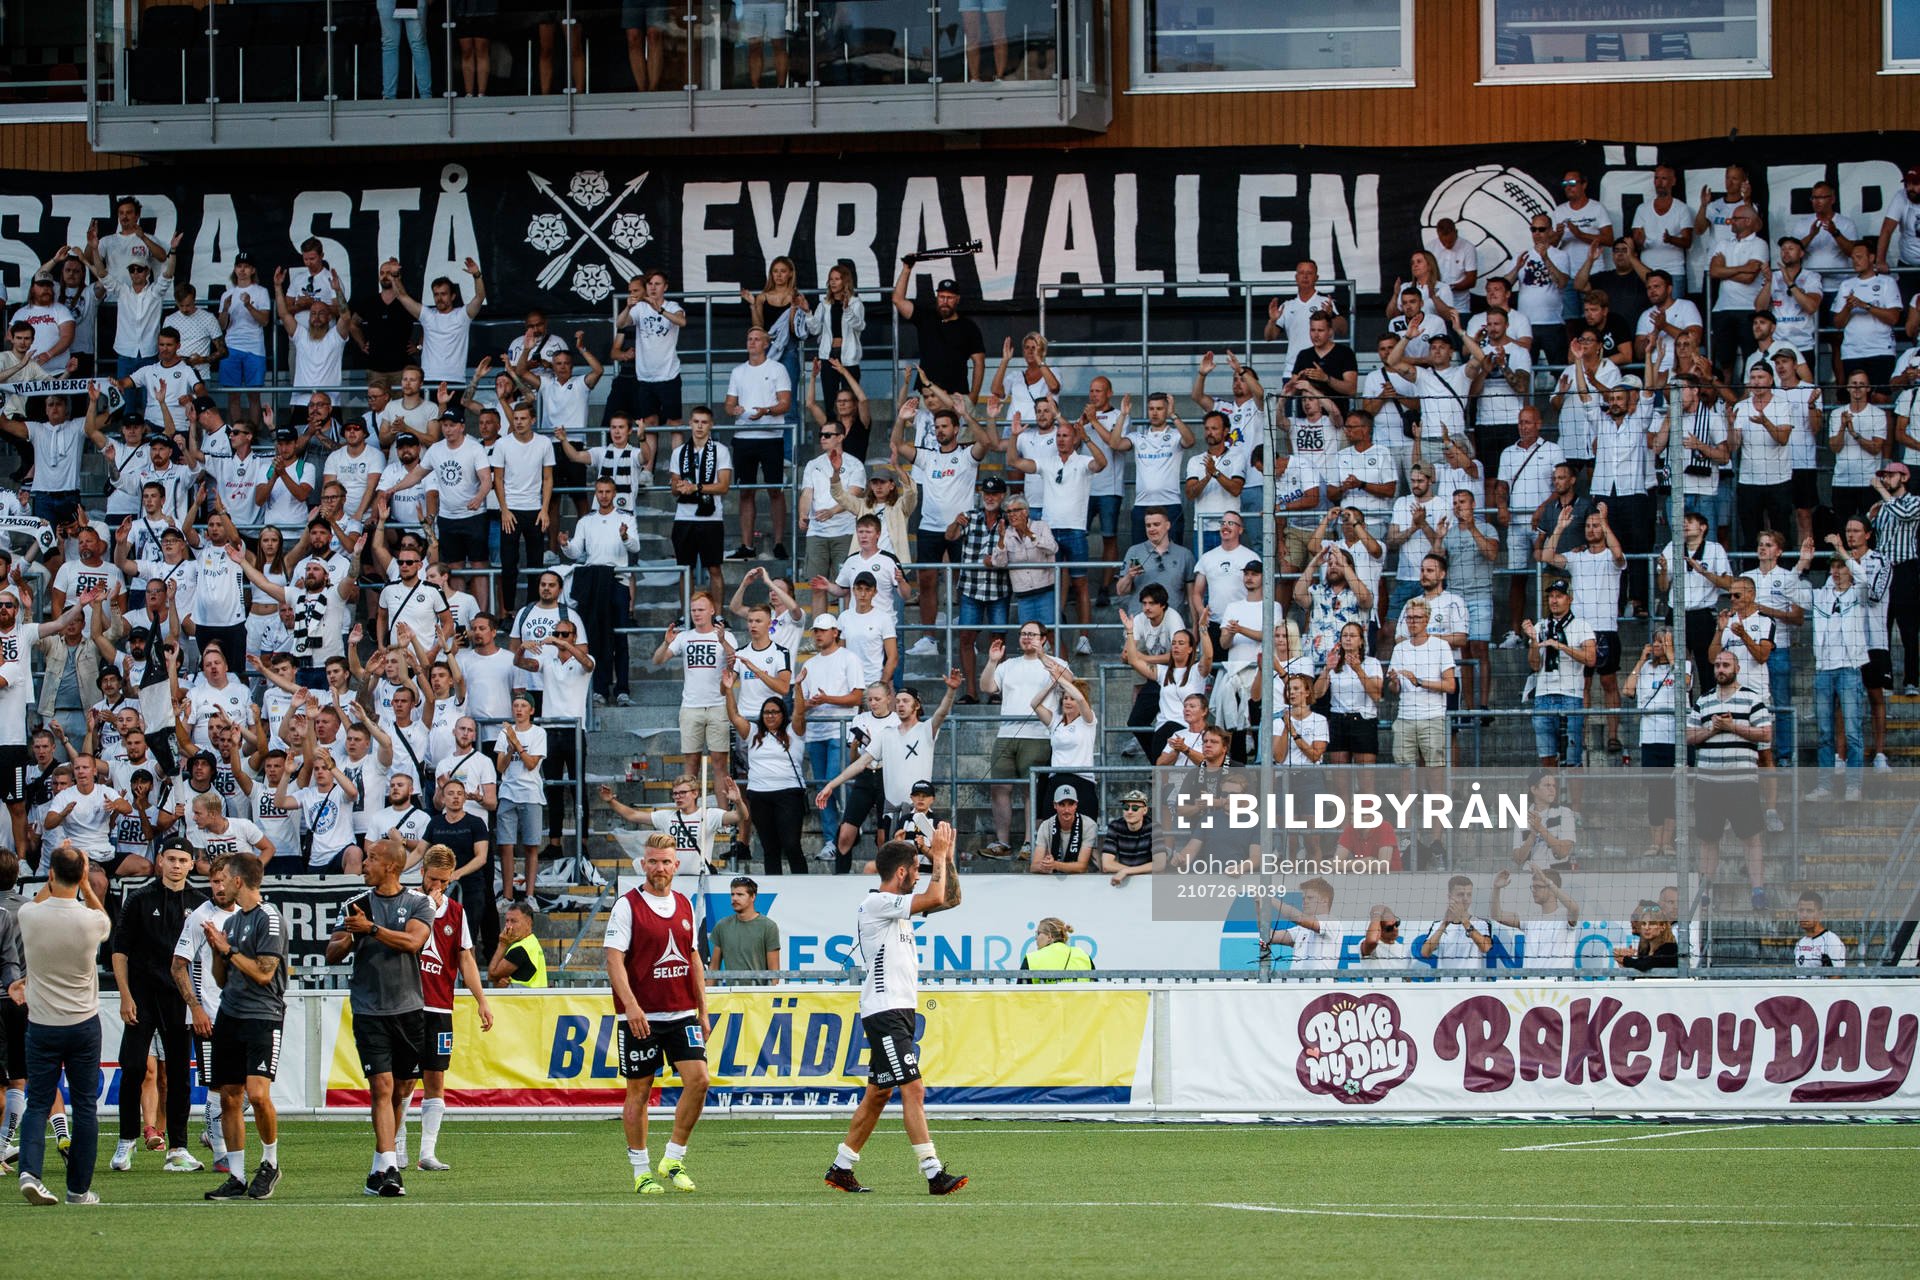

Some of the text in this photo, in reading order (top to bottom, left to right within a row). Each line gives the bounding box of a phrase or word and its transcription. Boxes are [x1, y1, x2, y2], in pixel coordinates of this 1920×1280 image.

[288, 163, 487, 307] STÅ
[682, 173, 1380, 304] EYRAVALLEN
[1297, 438, 1324, 450] BRO
[686, 642, 717, 655] ÖRE
[687, 654, 717, 667] BRO
[207, 841, 238, 855] ÖRE
[676, 836, 698, 849] RO
[419, 960, 443, 976] LECT
[653, 965, 690, 979] SELECT
[717, 1092, 859, 1107] WORKWEA
